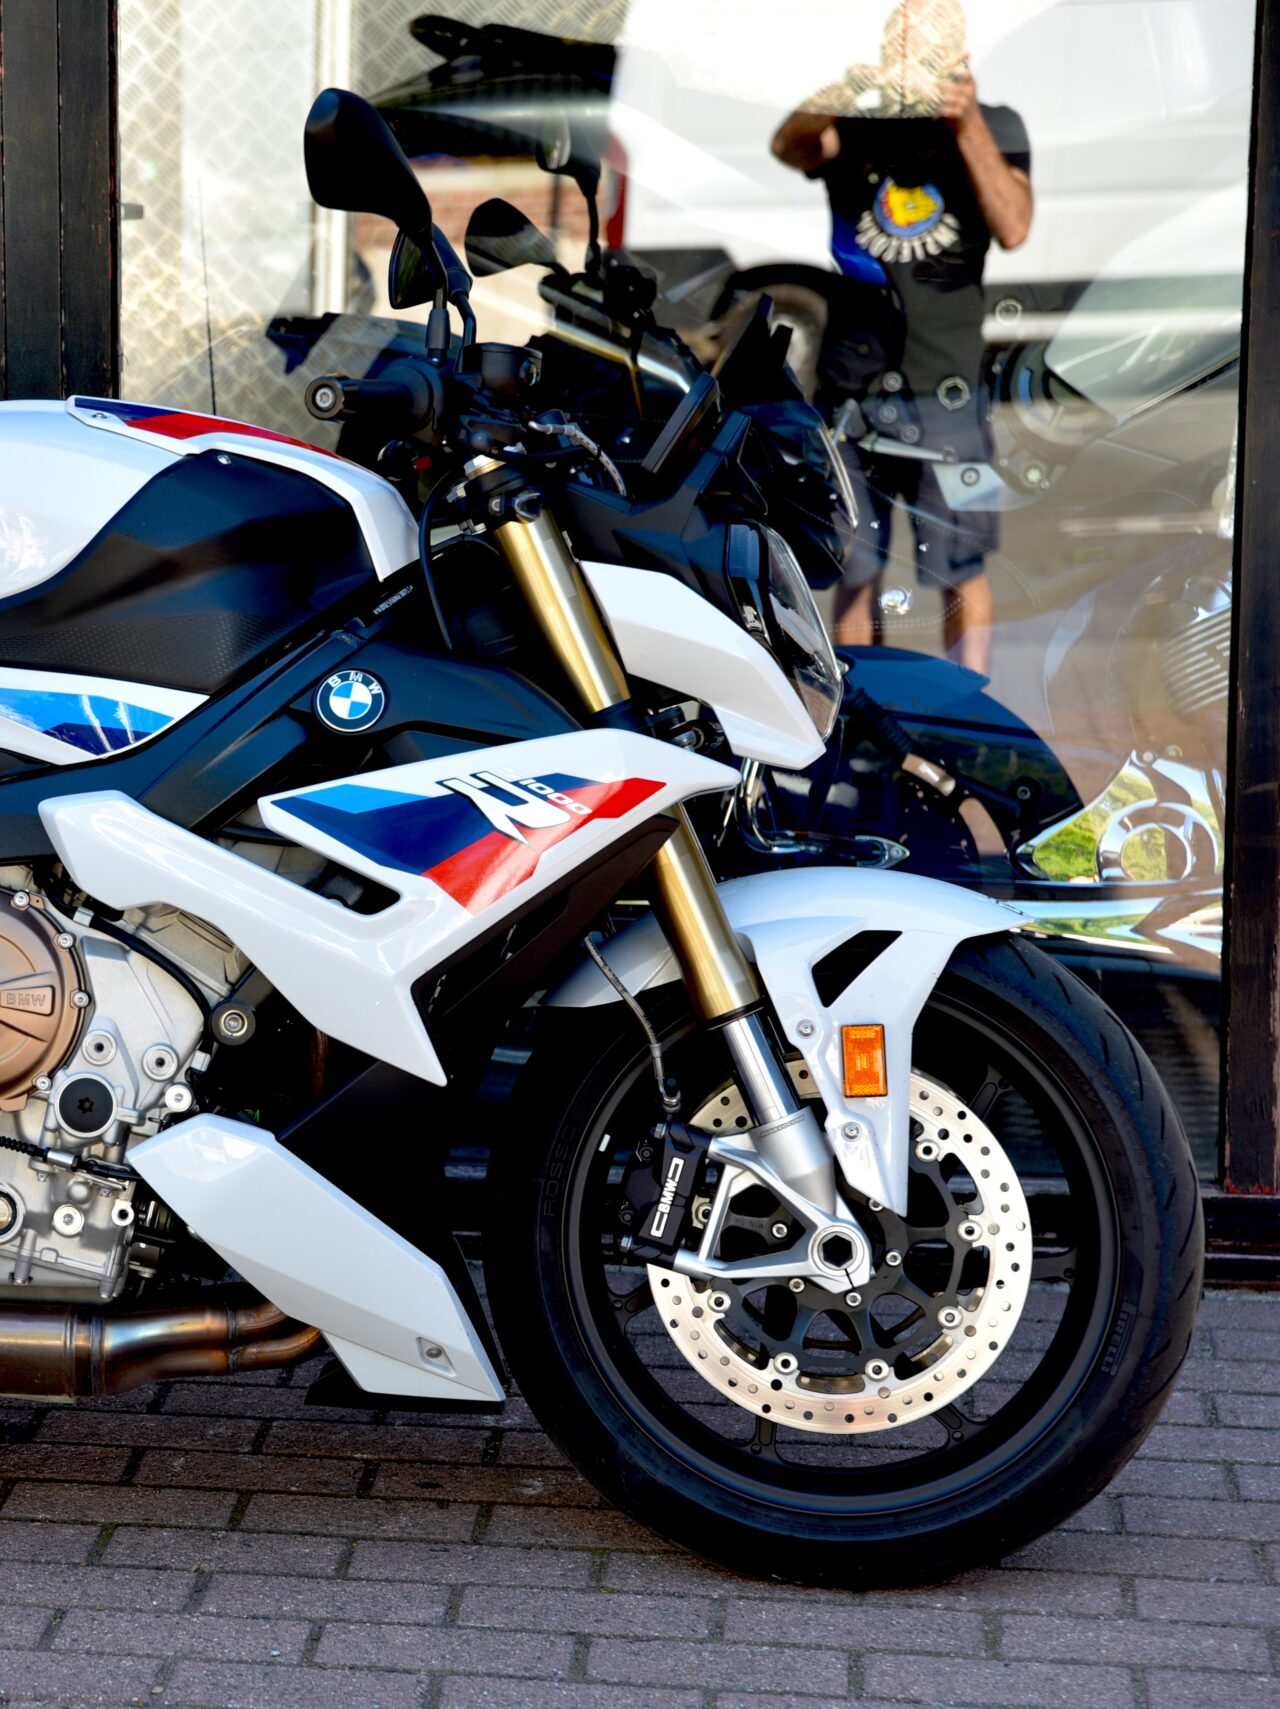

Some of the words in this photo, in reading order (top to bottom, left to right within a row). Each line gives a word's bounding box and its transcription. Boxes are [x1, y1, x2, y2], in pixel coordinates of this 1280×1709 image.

[327, 671, 382, 695] BMW
[6, 992, 47, 1007] BMW
[543, 1125, 576, 1217] ROSSO
[658, 1176, 678, 1214] BMW
[1100, 1301, 1139, 1377] PIRELLI
